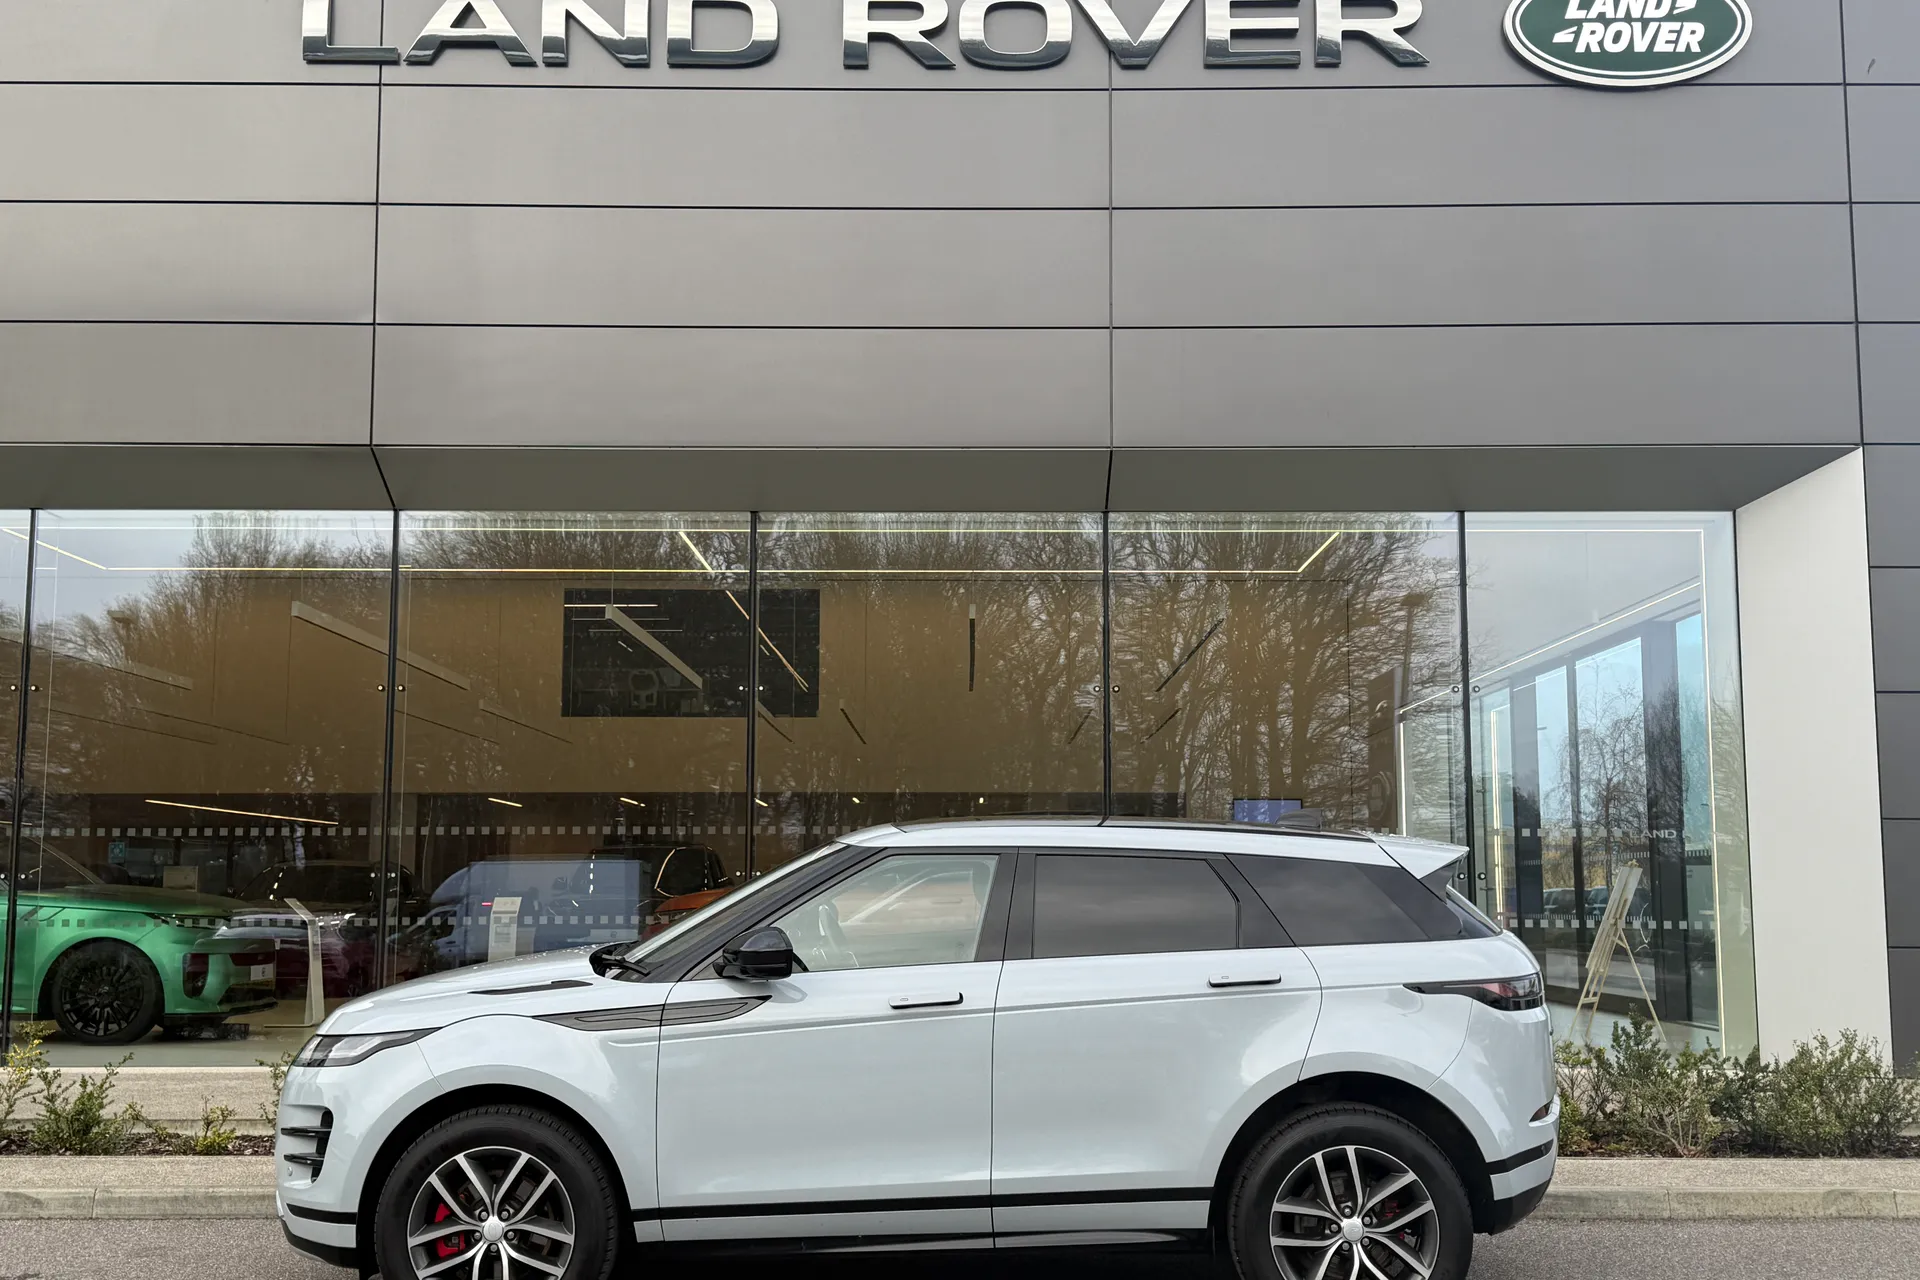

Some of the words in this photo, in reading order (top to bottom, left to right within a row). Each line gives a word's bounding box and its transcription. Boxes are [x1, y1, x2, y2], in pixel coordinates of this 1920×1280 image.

[1564, 0, 1672, 19] LAND
[302, 0, 779, 69] LAND
[843, 0, 1430, 70] ROVER
[1575, 21, 1705, 53] ROVER
[1630, 829, 1677, 839] LAND
